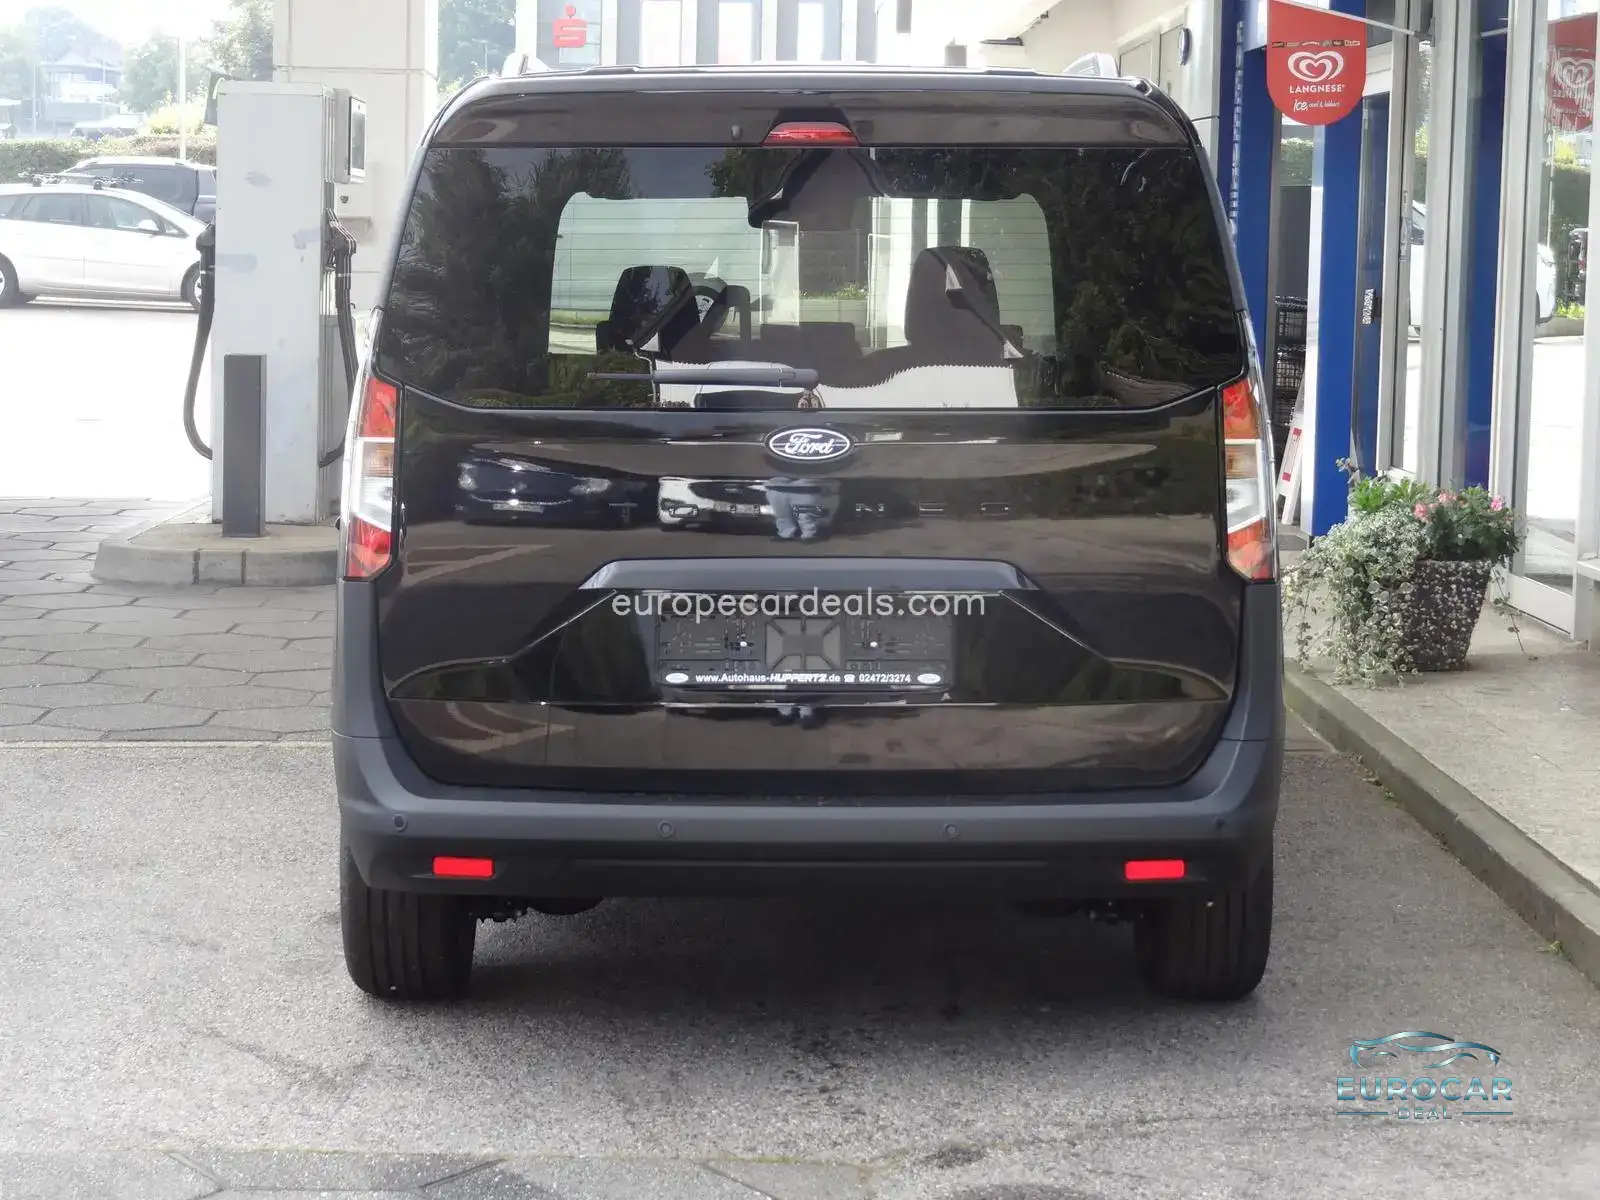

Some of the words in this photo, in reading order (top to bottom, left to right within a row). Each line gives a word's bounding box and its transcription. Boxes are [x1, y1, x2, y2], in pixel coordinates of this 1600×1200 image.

[1289, 84, 1343, 94] LANGNESE
[784, 432, 836, 454] Ford
[858, 673, 912, 684] 02472/3274
